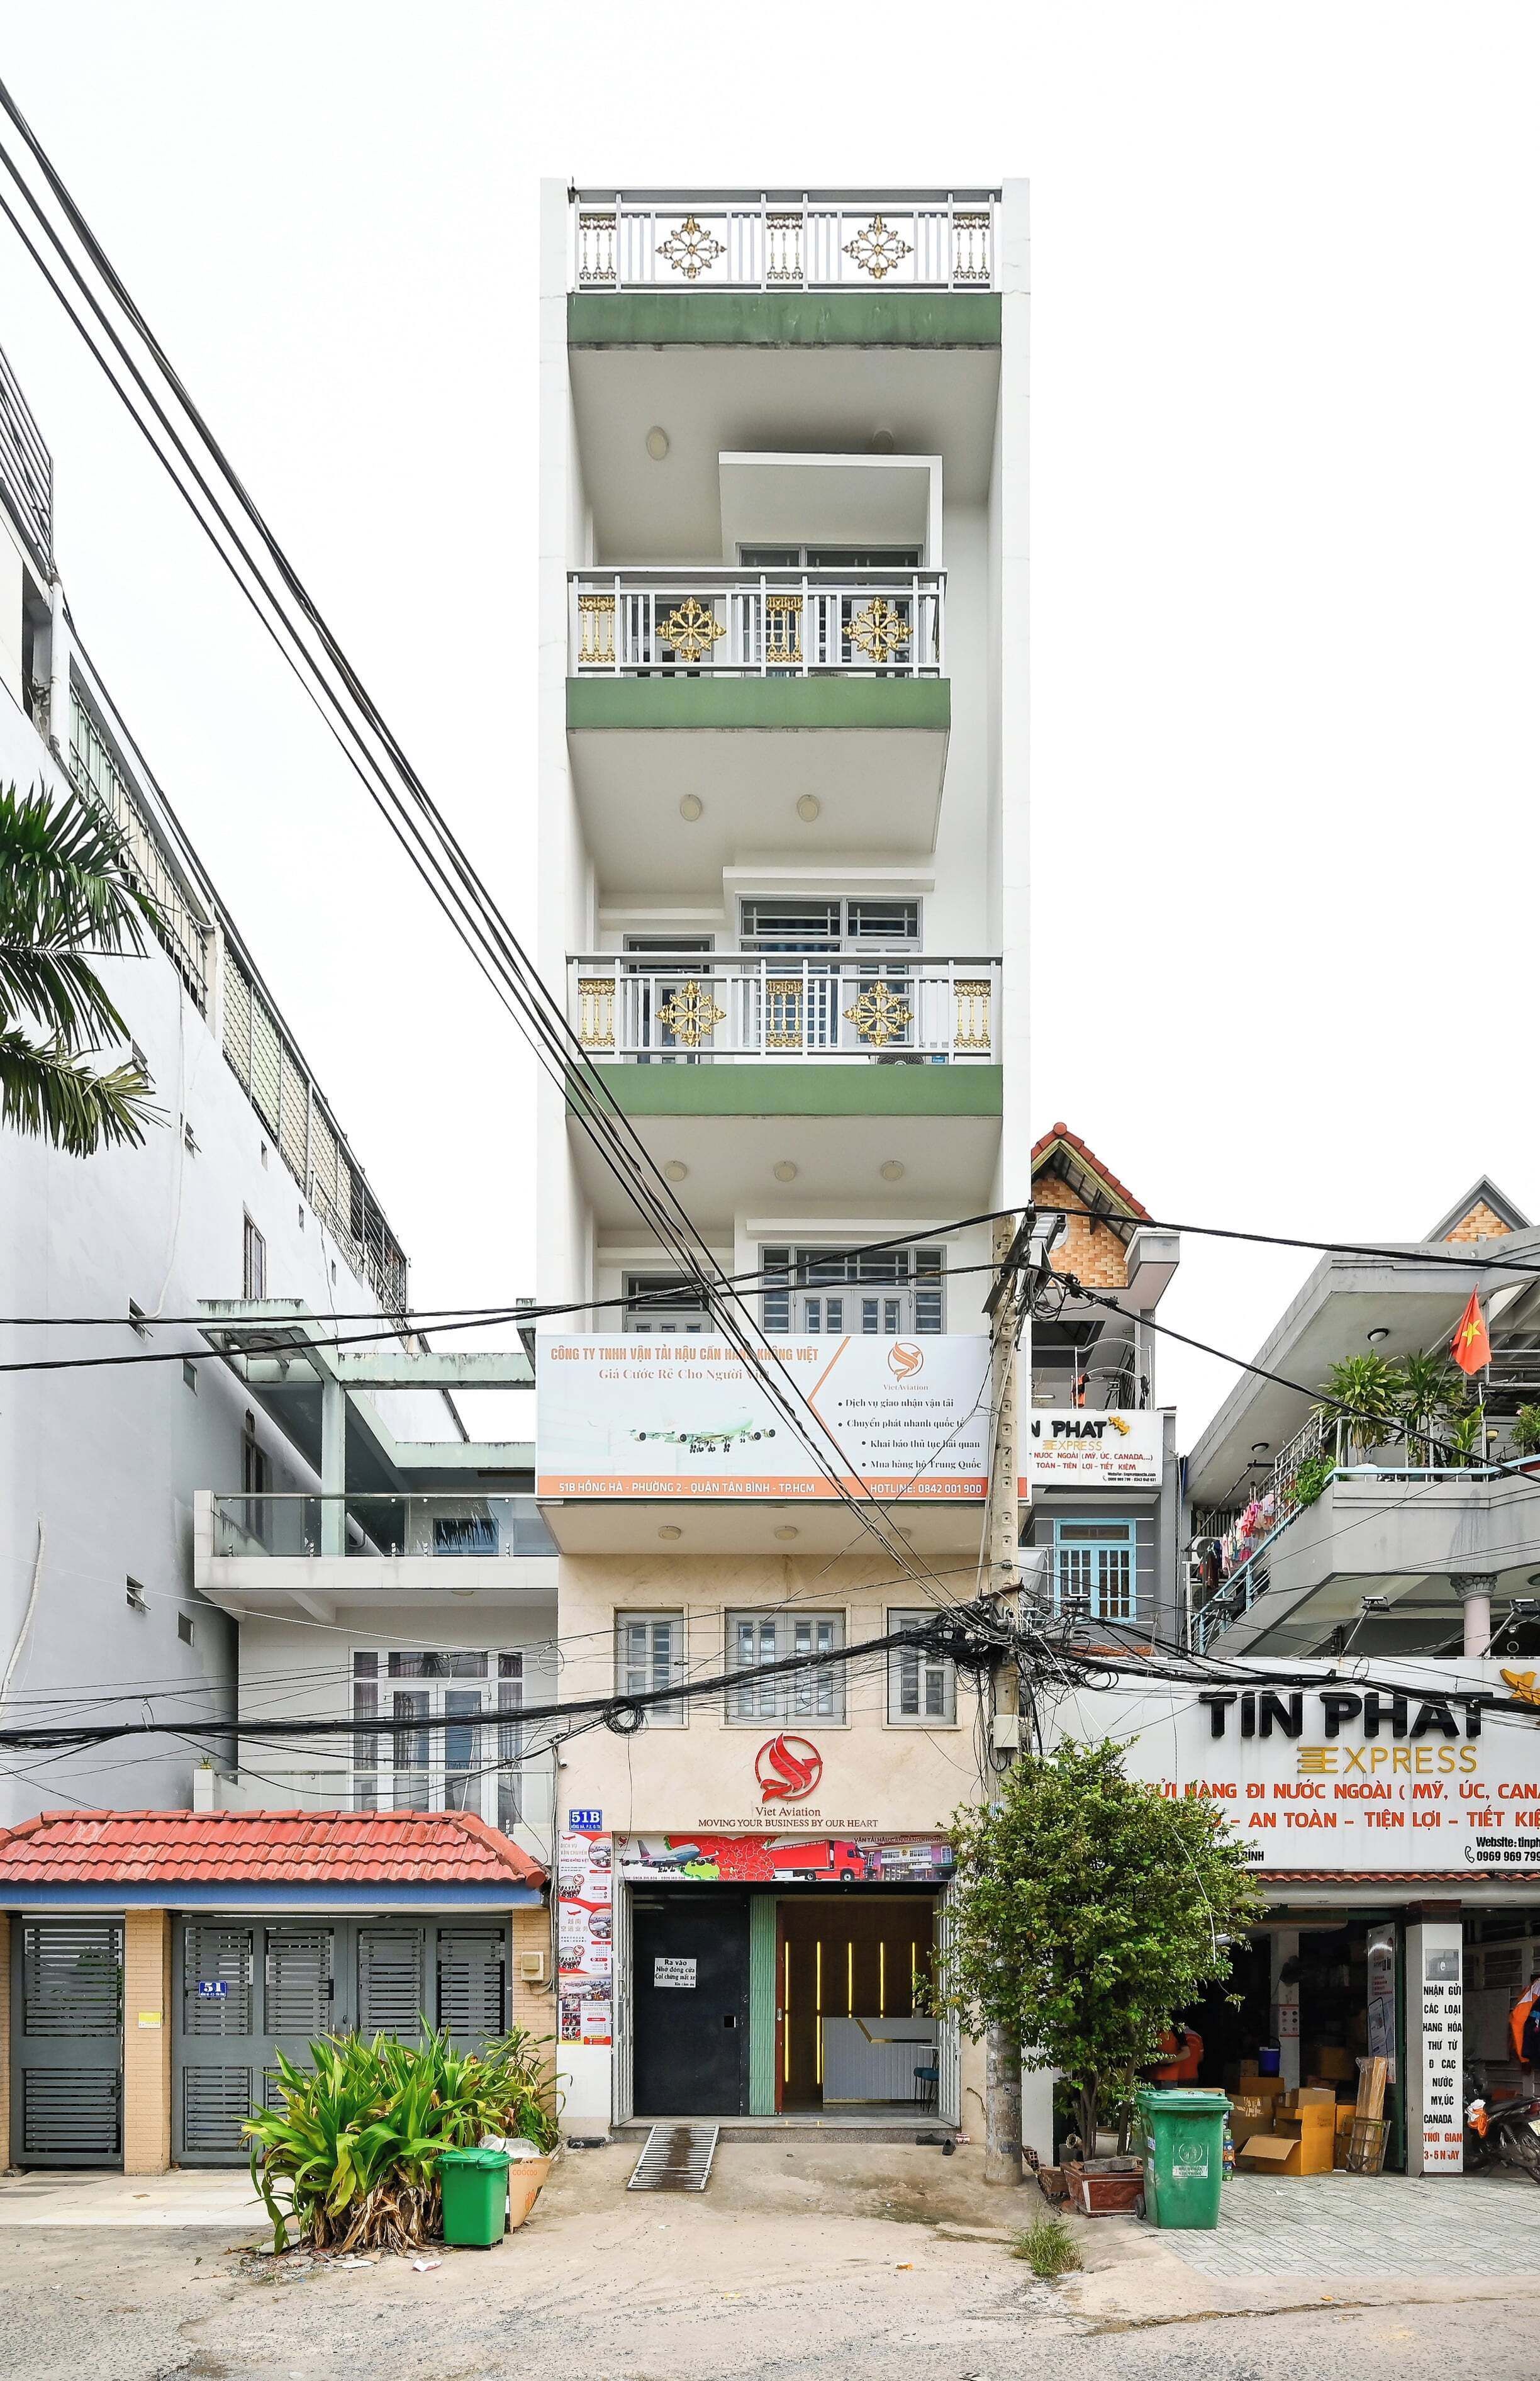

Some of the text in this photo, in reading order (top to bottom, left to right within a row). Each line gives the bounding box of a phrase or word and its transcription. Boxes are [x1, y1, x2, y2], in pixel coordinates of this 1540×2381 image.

[550, 1345, 579, 1360] CÔNG
[583, 1348, 595, 1360] TY
[599, 1348, 627, 1360] TNHH
[630, 1345, 651, 1362] VẬN
[655, 1344, 671, 1360] TẢI
[675, 1345, 696, 1362] HẬU
[725, 1345, 754, 1360] HÀN
[757, 1345, 793, 1361] KHÔNG
[796, 1346, 818, 1363] VIỆT
[599, 1368, 620, 1379] Giá
[623, 1368, 654, 1379] Cước
[678, 1369, 703, 1379] Cho
[706, 1369, 742, 1381] Người
[845, 1398, 866, 1409] Dịch
[868, 1401, 878, 1409] vụ
[881, 1398, 899, 1408] giao
[901, 1398, 920, 1409] nhận
[925, 1398, 940, 1409] vận
[883, 1418, 901, 1429] phát
[904, 1419, 932, 1428] nhanh
[934, 1416, 954, 1429] quốc
[1051, 1421, 1107, 1438] PHAT
[871, 1439, 890, 1448] Khai
[893, 1439, 908, 1448] báo
[927, 1440, 940, 1450] tục
[959, 1440, 981, 1450] quan
[1042, 1440, 1103, 1451] EXPRESS
[871, 1460, 890, 1469] Mua
[892, 1460, 913, 1470] hàng
[930, 1460, 956, 1470] Trung
[958, 1457, 981, 1470] Quốc
[578, 1480, 606, 1492] HỒNG
[609, 1481, 623, 1492] HÀ
[632, 1481, 674, 1492] PHƯỜNG
[676, 1482, 682, 1492] 2
[691, 1481, 720, 1494] QUẬN
[722, 1481, 744, 1493] TÂN
[746, 1481, 770, 1493] BÌNH
[779, 1483, 815, 1493] TP.HCM
[869, 1484, 983, 1494] HOTLINE: 0842 001 900
[1199, 1691, 1493, 1739] TIN PHAT
[1297, 1745, 1478, 1774] EXPRESS
[1185, 1779, 1237, 1799] HÀNG
[1246, 1783, 1265, 1799] ĐI
[1273, 1779, 1326, 1799] NƯỚC
[1334, 1780, 1392, 1799] NGOÀI
[1412, 1780, 1448, 1801] MỸ,
[1459, 1779, 1490, 1801] ÚC,
[571, 1811, 600, 1824] 51B
[755, 1807, 821, 1817] Viet Aviation
[1248, 1812, 1276, 1827] AN
[1283, 1808, 1337, 1828] TOÀN
[1364, 1809, 1405, 1830] TIỆN
[1412, 1810, 1441, 1830] LỢI
[1466, 1805, 1505, 1827] TIẾT
[698, 1819, 879, 1828] MOVING YOUR BUSINESS BY OUR HEART
[1476, 1836, 1517, 1848] Website:
[1476, 1851, 1501, 1862] 0969
[1503, 1851, 1522, 1862] 969
[203, 1982, 222, 1992] 51
[1423, 1983, 1461, 1998] NHẬN GỬI
[1424, 2002, 1461, 2016] CÁC LOẠI
[1448, 2020, 1463, 2032] HÓA
[1427, 2039, 1458, 2051] THƯ TỪ
[1441, 2059, 1456, 2069] CAC
[1432, 2075, 1453, 2088] NƯỚC
[1424, 2114, 1453, 2124] CANADA
[1444, 2132, 1463, 2143] GIAN
